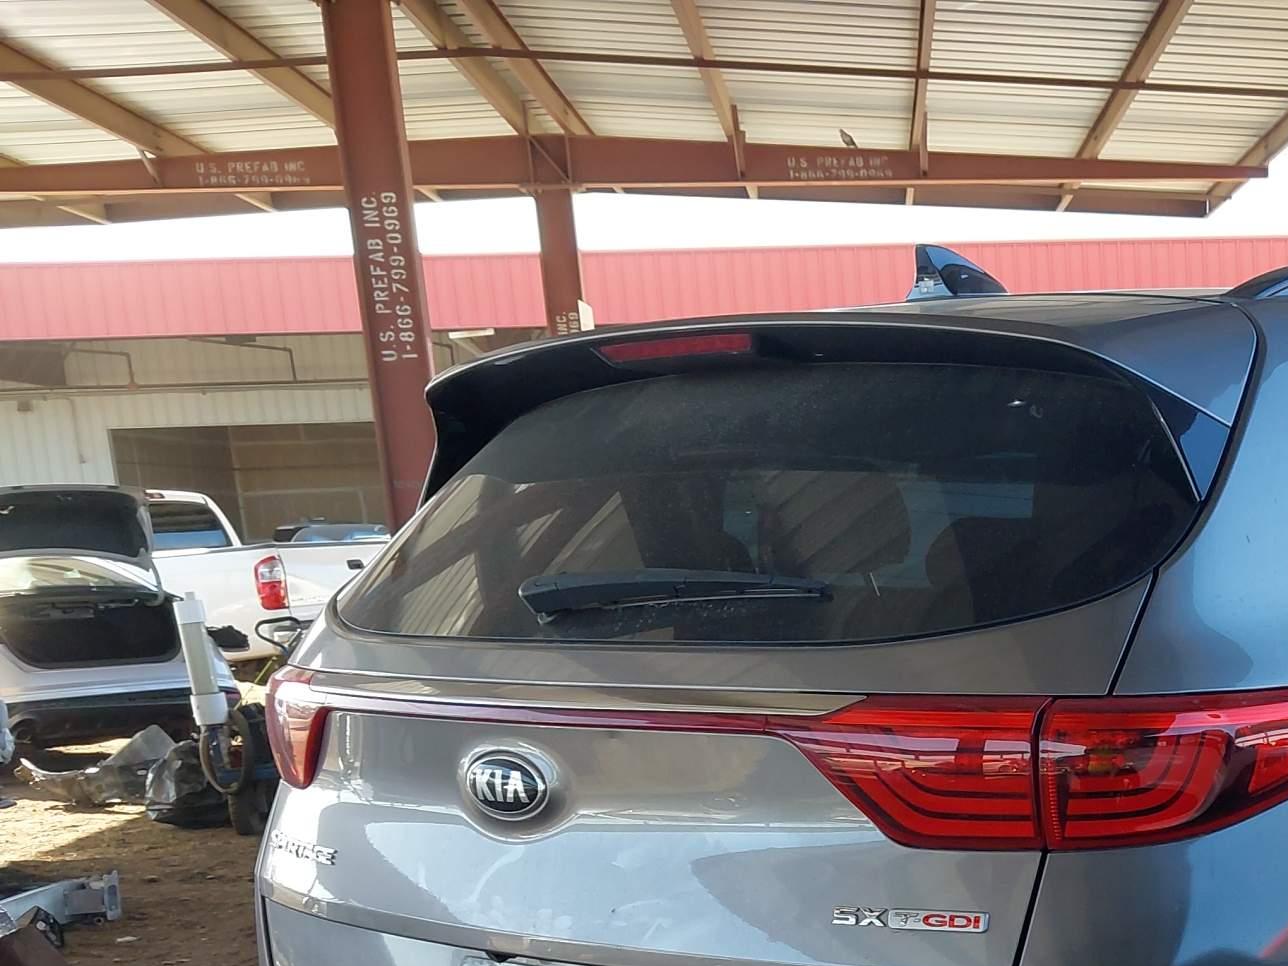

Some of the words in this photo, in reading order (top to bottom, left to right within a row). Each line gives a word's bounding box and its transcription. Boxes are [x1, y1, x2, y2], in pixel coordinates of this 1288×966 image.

[366, 238, 393, 314] PREFAB
[380, 191, 419, 359] 1-866-799-0969
[379, 324, 398, 362] U.S.
[472, 768, 530, 803] KIA
[831, 906, 888, 928] SX
